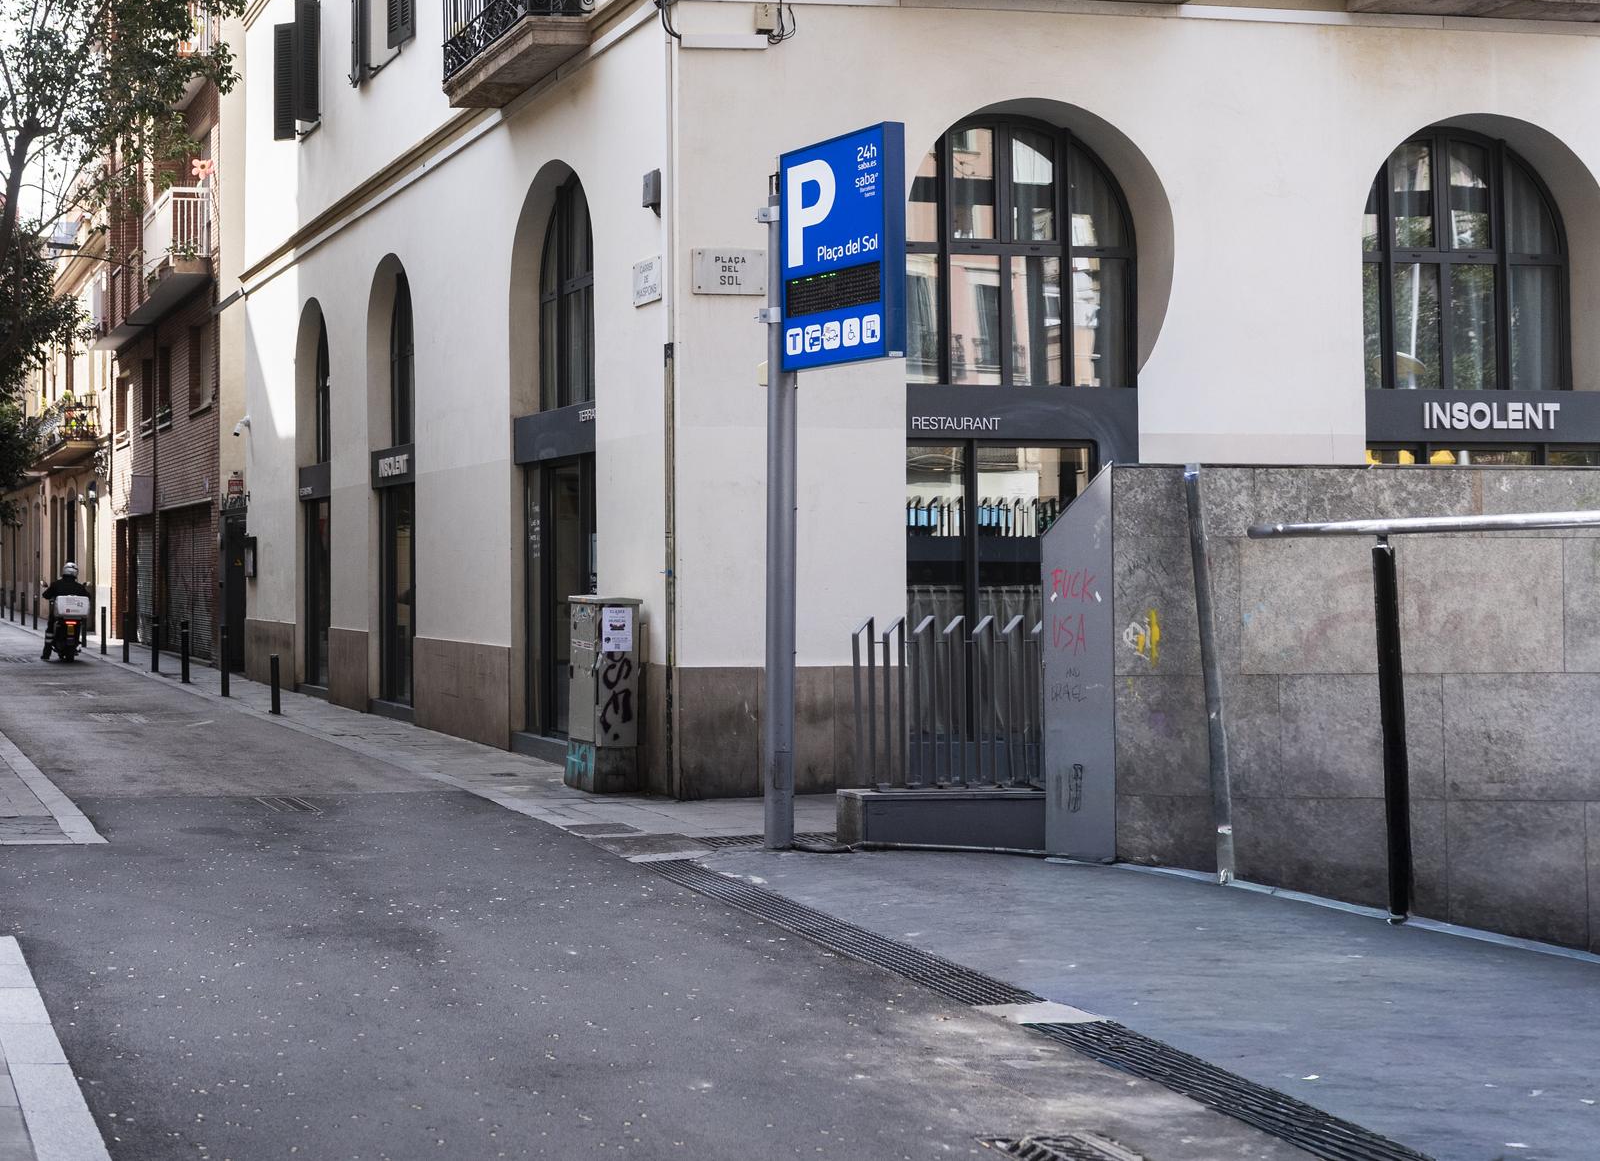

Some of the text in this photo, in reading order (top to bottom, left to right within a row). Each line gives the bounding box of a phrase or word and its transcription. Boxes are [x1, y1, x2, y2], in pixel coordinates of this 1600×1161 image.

[856, 142, 877, 162] 24h
[855, 172, 876, 188] saba
[787, 159, 836, 268] P
[817, 233, 878, 262] Plaça del Sol
[714, 256, 746, 265] PLAÇA
[721, 265, 739, 273] DEL
[719, 275, 742, 286] SOL
[911, 416, 1001, 431] RESTAURANT
[1423, 401, 1561, 430] INSOLENT
[378, 454, 409, 478] INSOLENT
[1051, 568, 1096, 604] FUCK
[1053, 613, 1087, 657] USA
